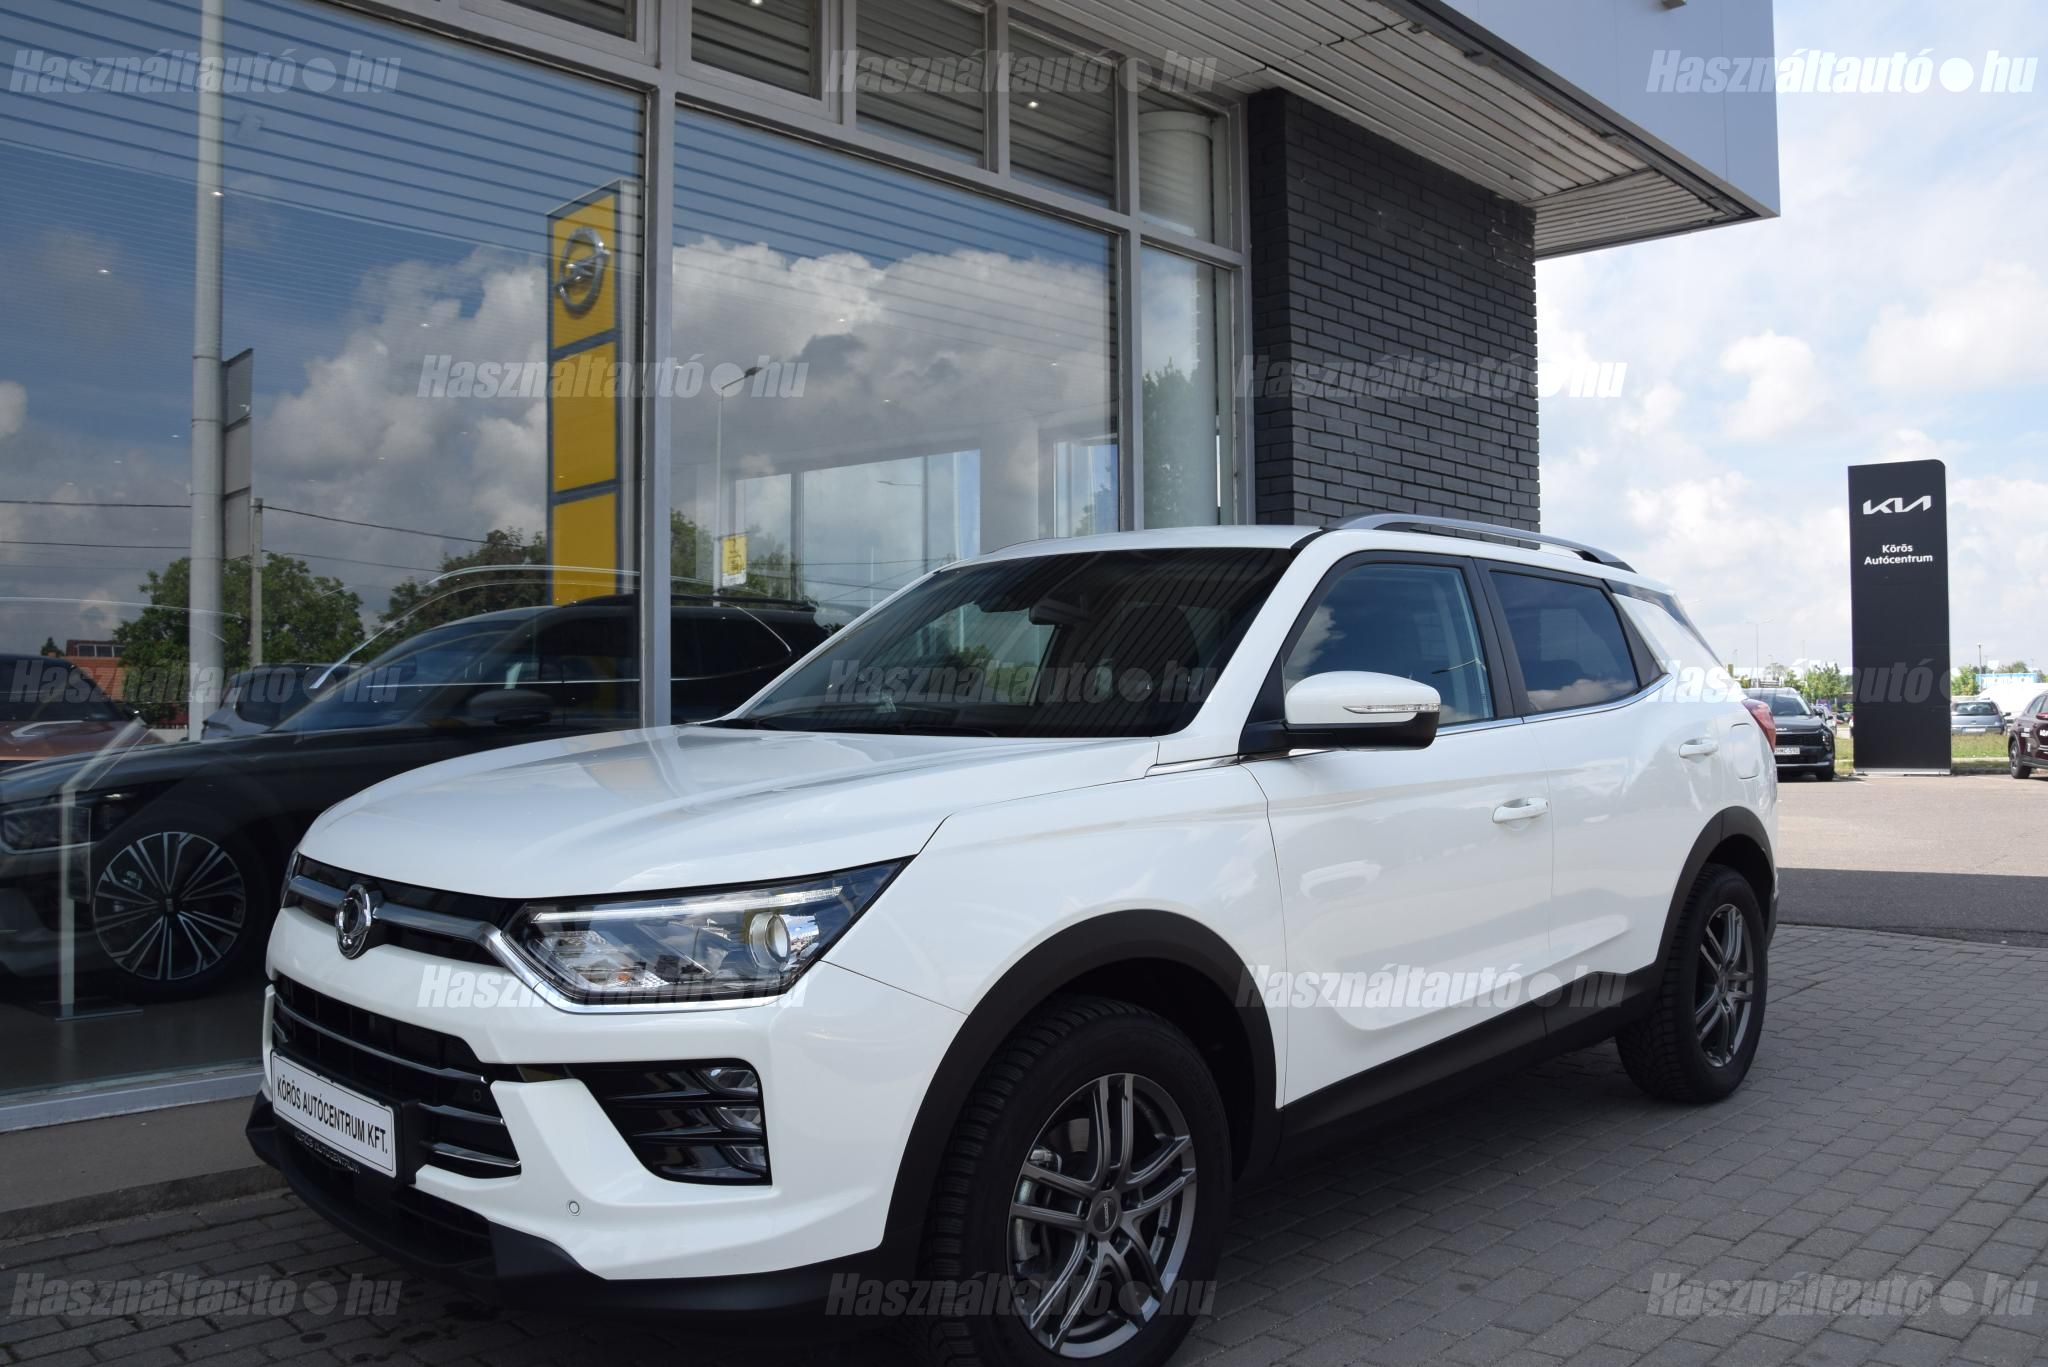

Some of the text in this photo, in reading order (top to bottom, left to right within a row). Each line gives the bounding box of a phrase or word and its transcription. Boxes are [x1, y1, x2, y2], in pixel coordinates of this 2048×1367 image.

[1864, 554, 1933, 565] Autócentrum
[303, 1092, 365, 1143] AUTÓCENTRUM
[367, 1123, 388, 1154] KFT.
